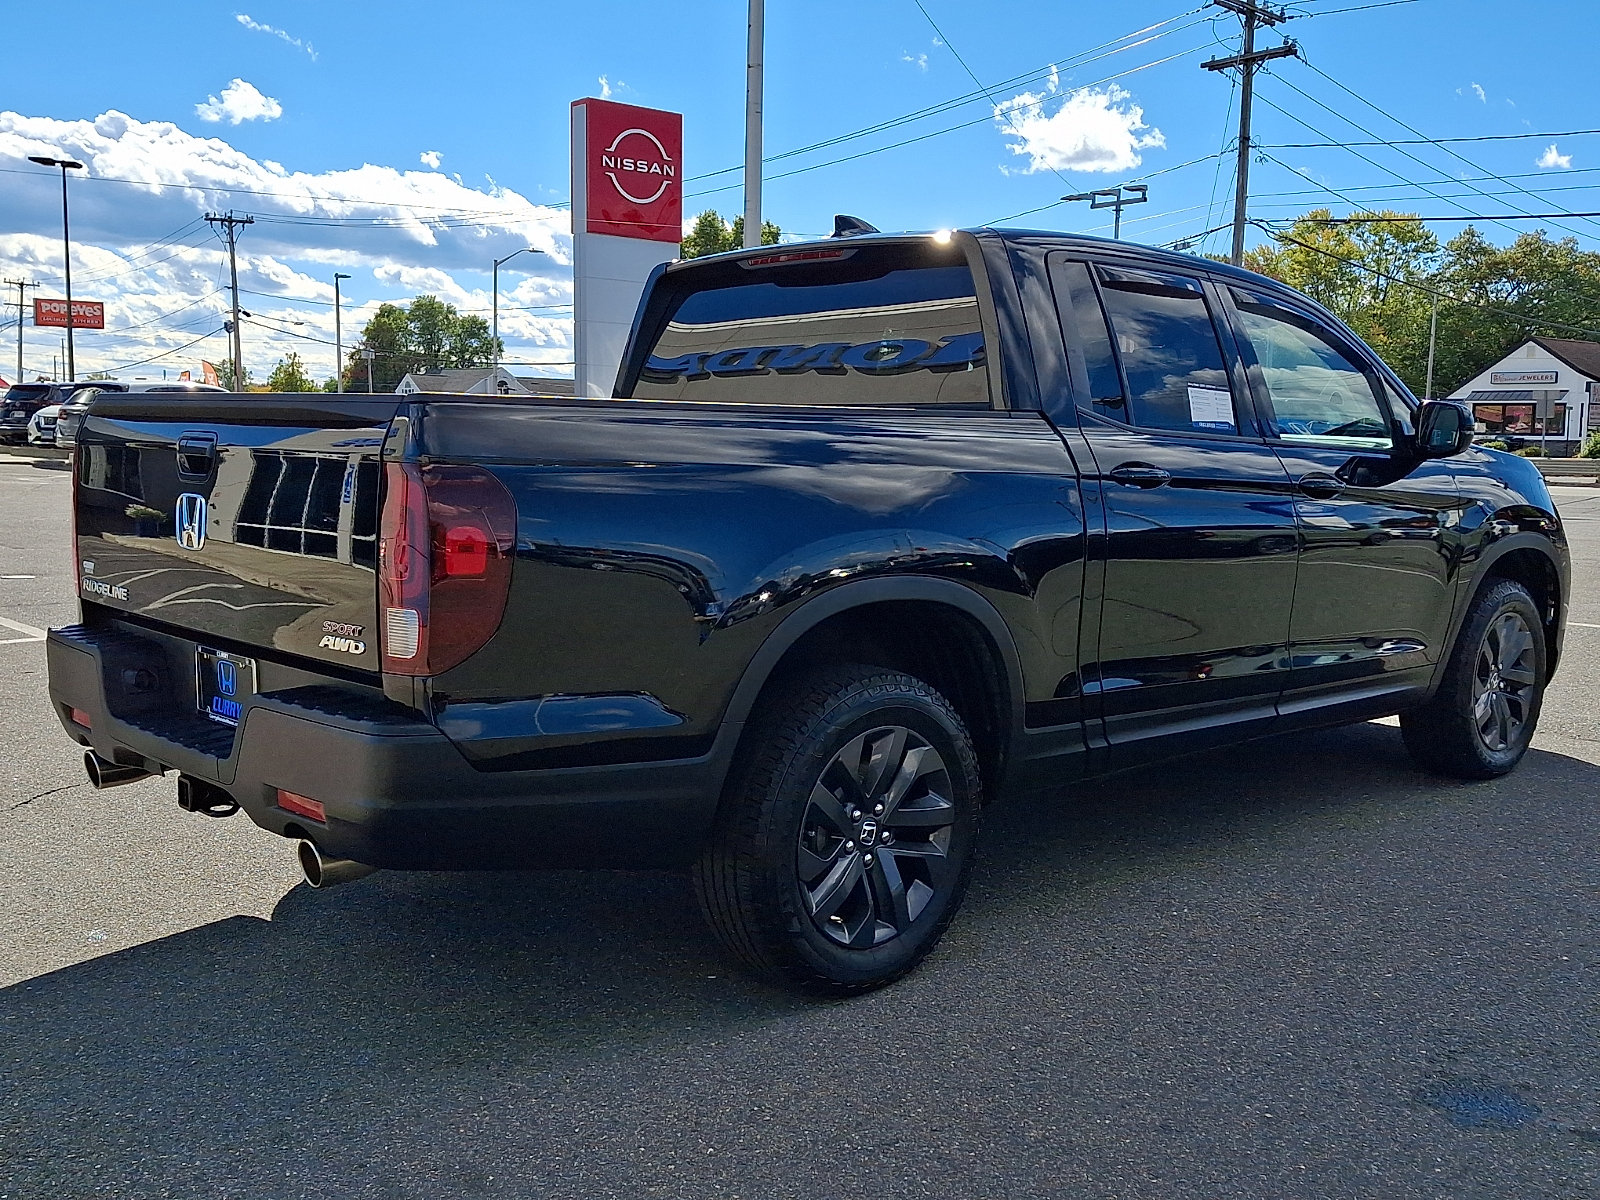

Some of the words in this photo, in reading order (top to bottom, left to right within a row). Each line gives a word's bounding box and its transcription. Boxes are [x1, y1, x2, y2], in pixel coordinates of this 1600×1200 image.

[602, 155, 675, 177] NISSAN
[83, 579, 128, 601] RIDGELINE
[322, 620, 364, 636] SPORT
[319, 635, 366, 654] AWD
[213, 696, 243, 719] CURRY
